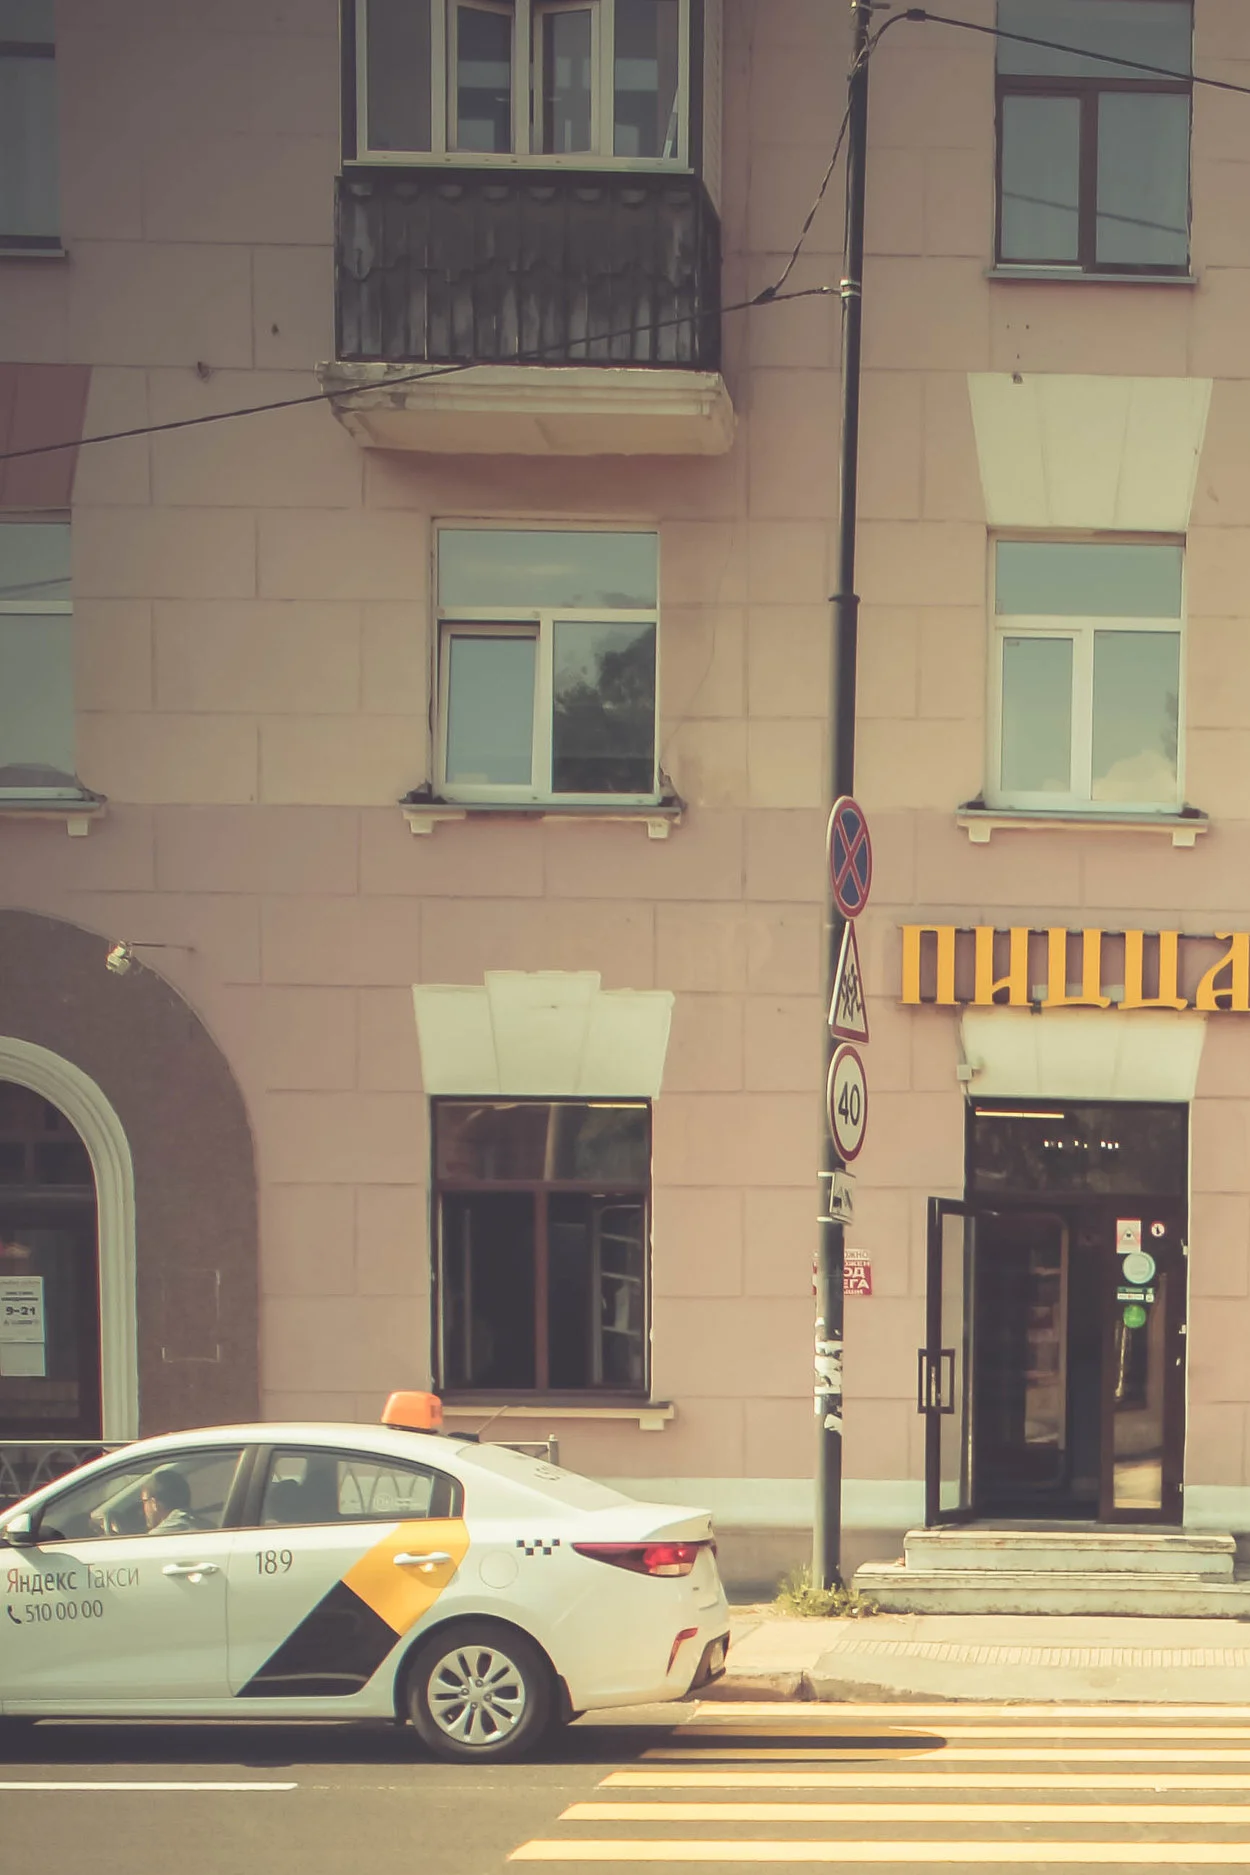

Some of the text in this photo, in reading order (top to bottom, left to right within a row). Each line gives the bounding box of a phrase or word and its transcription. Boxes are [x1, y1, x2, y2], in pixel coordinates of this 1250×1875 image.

[838, 1081, 861, 1126] 40
[255, 1549, 293, 1575] 189
[7, 1563, 140, 1595] Яндекс Такси
[25, 1599, 103, 1622] 510 00 00
